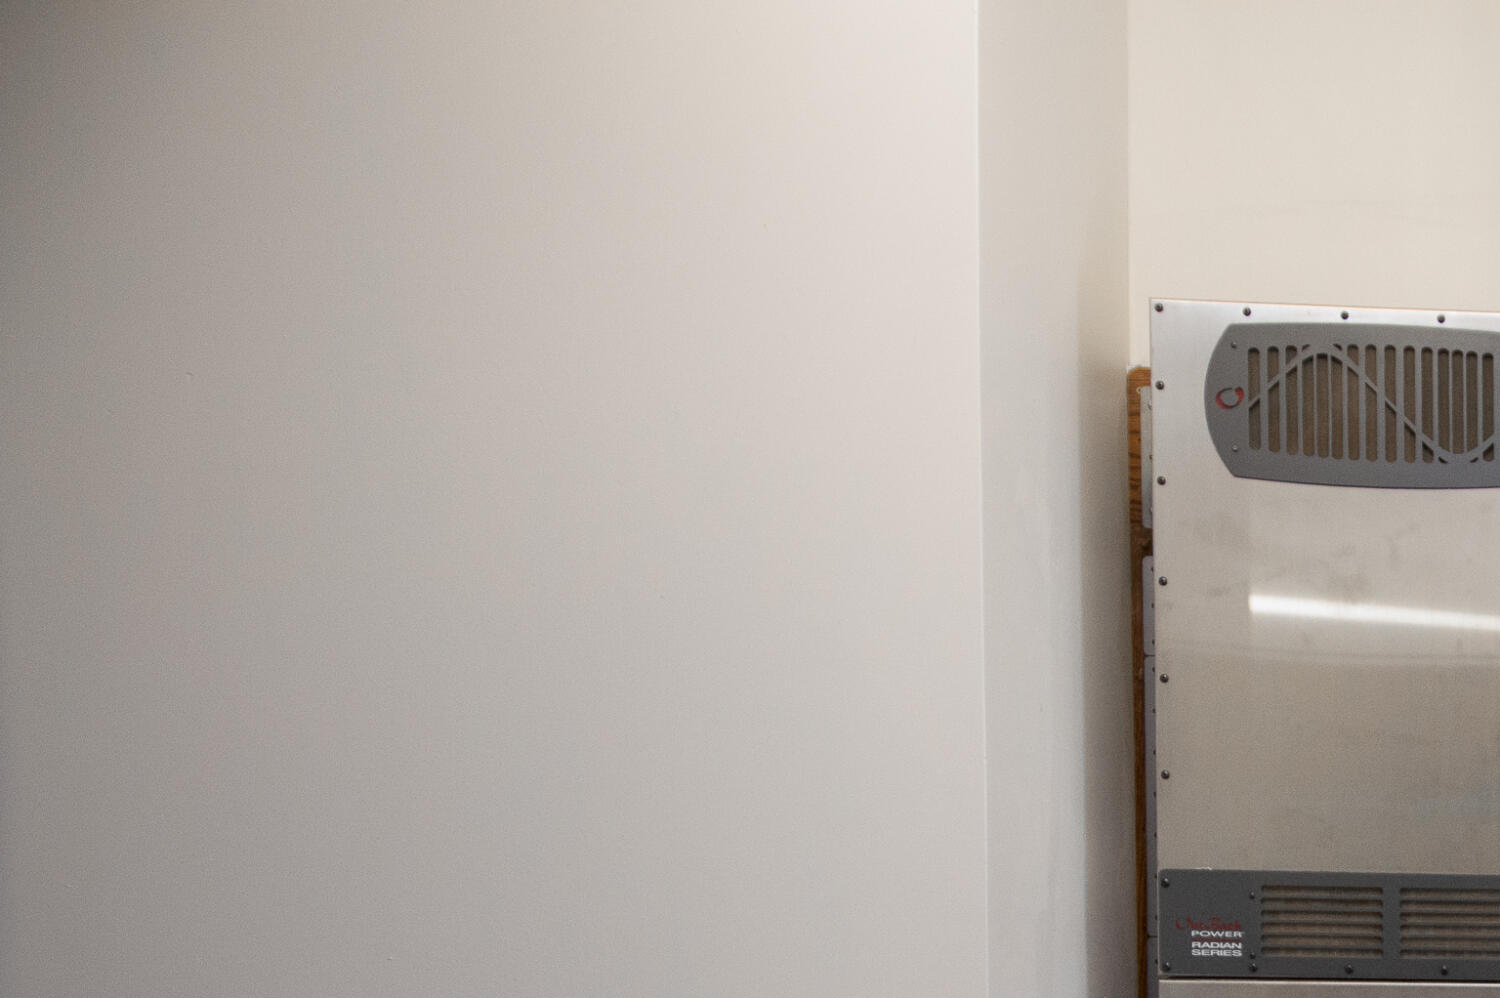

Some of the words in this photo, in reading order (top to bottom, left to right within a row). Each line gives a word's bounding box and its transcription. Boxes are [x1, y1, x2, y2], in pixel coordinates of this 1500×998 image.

[1191, 930, 1242, 938] POWER
[1191, 941, 1242, 949] RADIAN
[1191, 949, 1243, 957] SERIES
